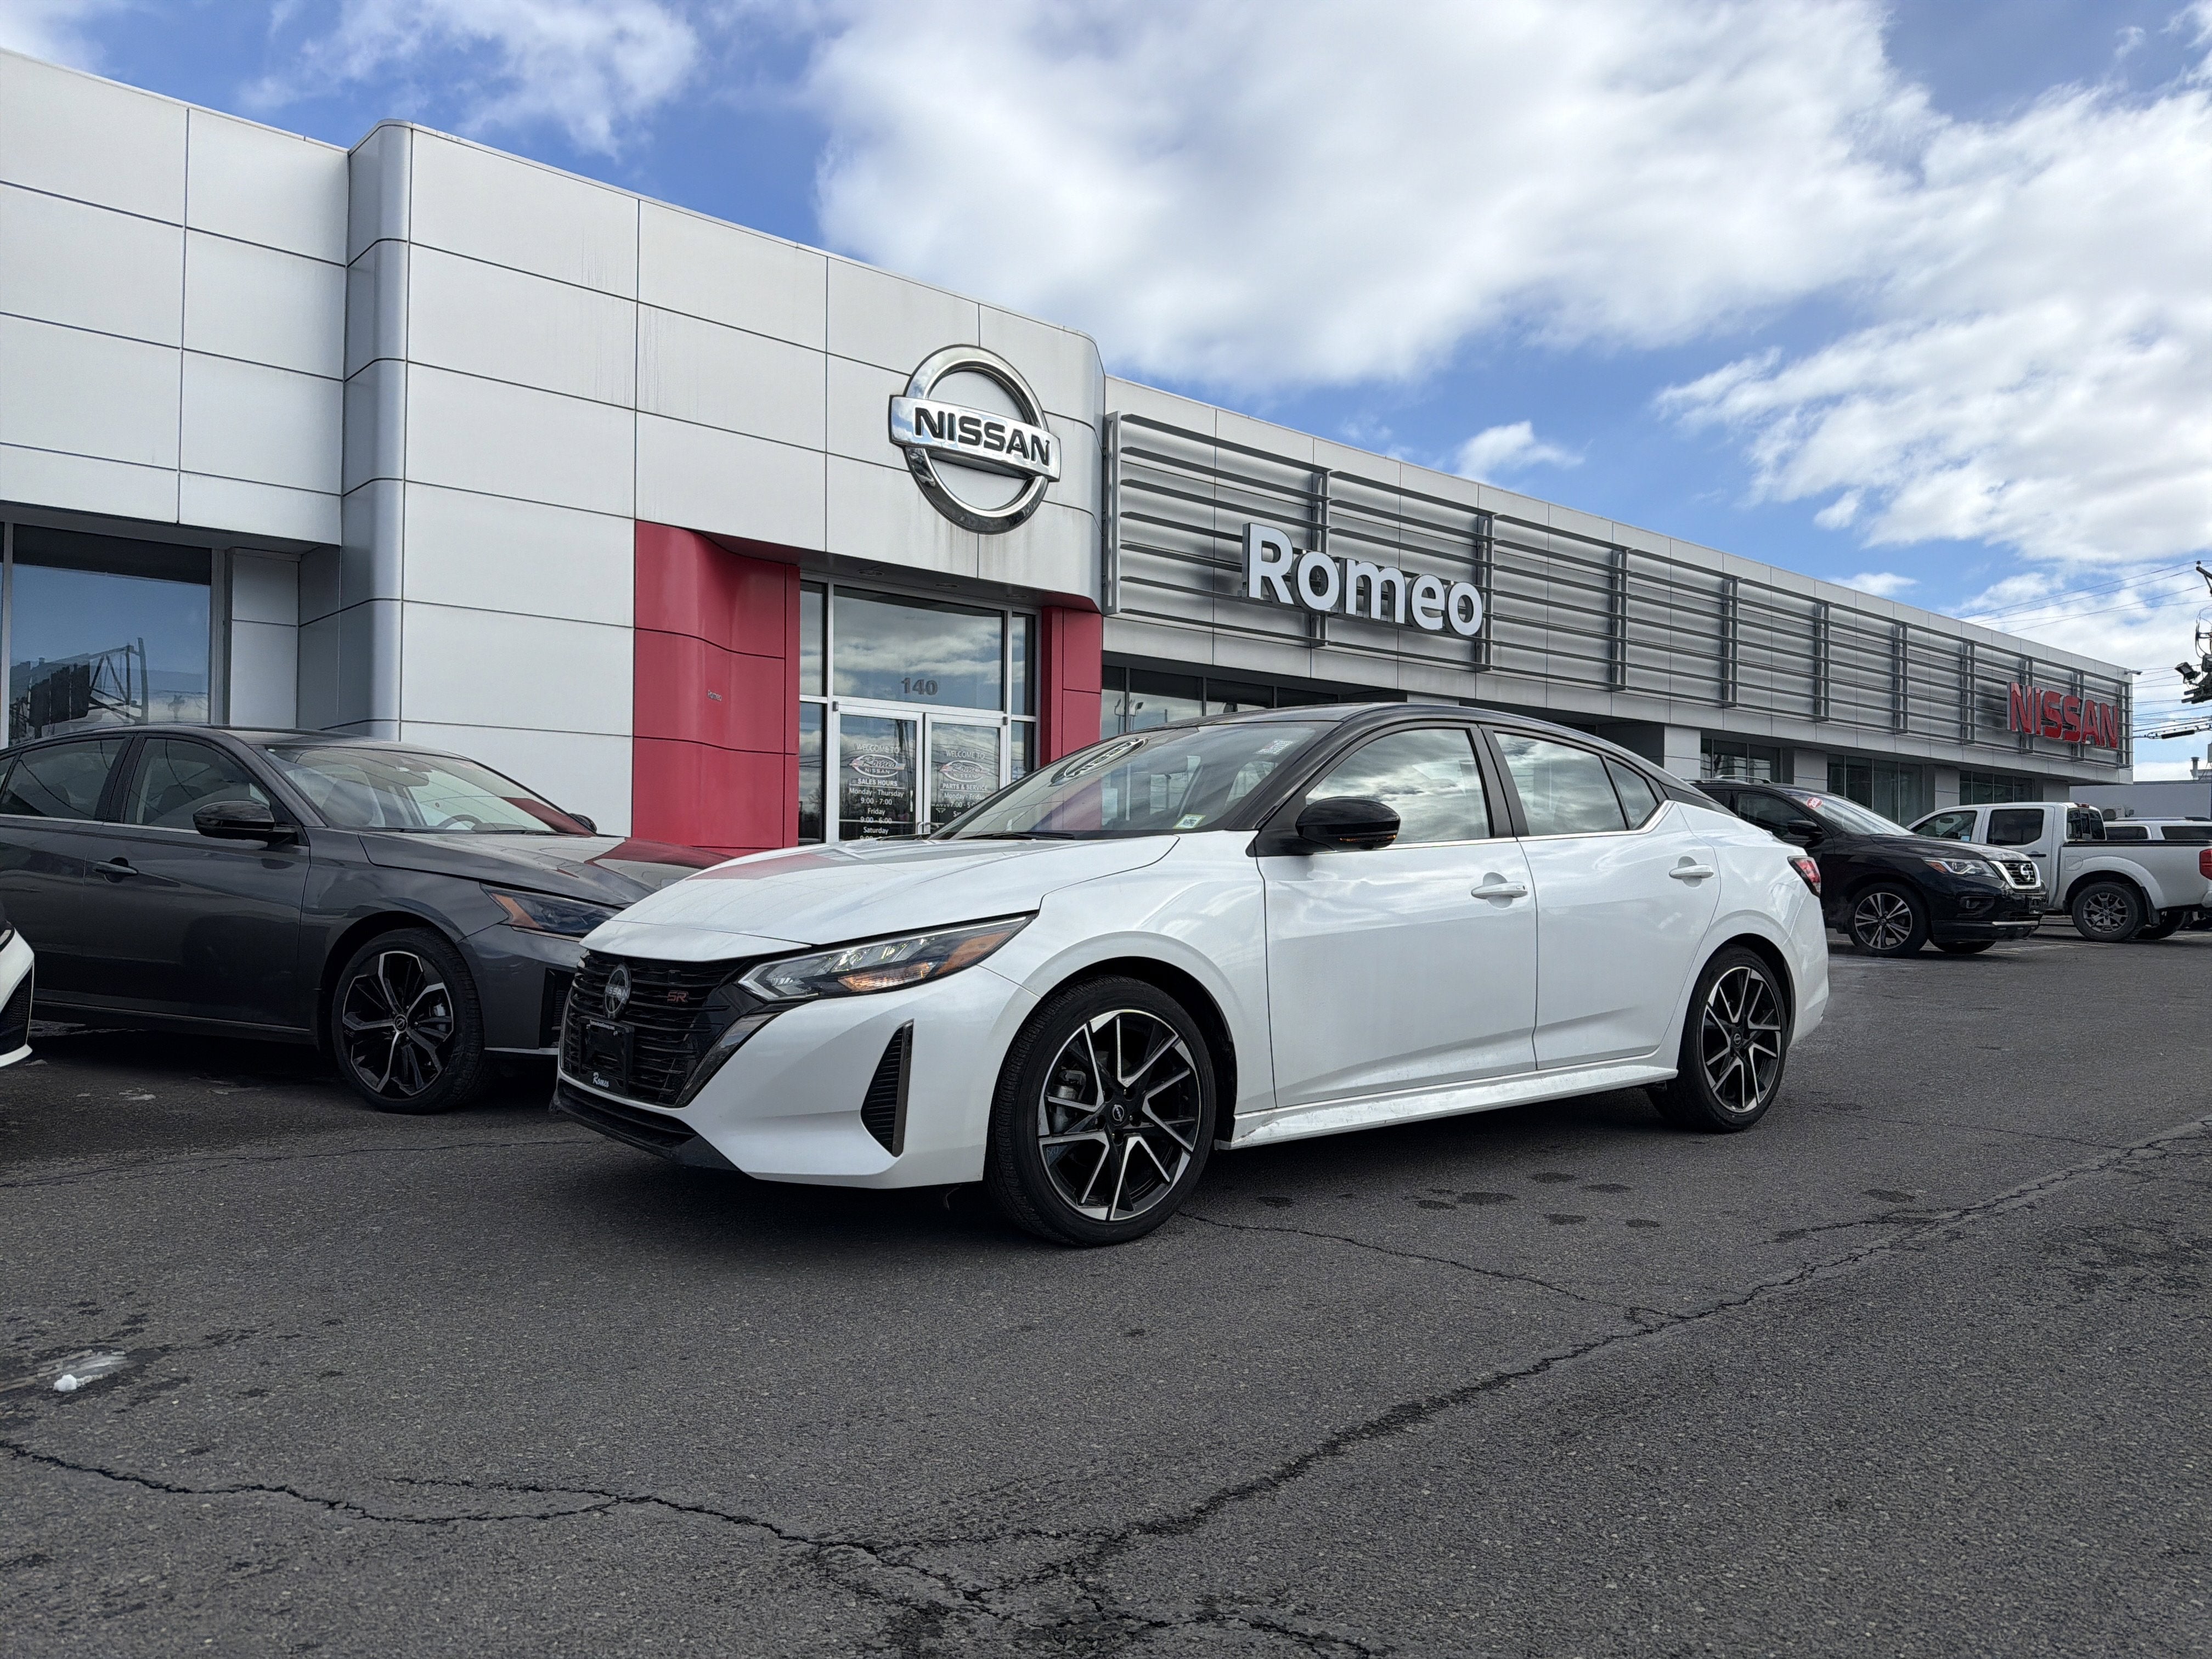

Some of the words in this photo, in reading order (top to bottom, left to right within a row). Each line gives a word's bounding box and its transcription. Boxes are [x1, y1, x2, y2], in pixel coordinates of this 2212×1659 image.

[915, 407, 1050, 466] NISSAN
[1243, 522, 1483, 636] Romeo
[901, 677, 938, 696] 140
[2007, 682, 2118, 749] NISSAN
[856, 743, 889, 753] WELCOME
[946, 750, 975, 758] WELCOME
[859, 755, 896, 768] Romeo
[849, 788, 872, 797] Monday
[877, 789, 905, 798] Thursday
[944, 793, 965, 801] Monday
[867, 808, 886, 816] Friday
[863, 827, 889, 835] Saturday
[606, 987, 629, 997] NISSAN
[667, 990, 688, 1003] SR
